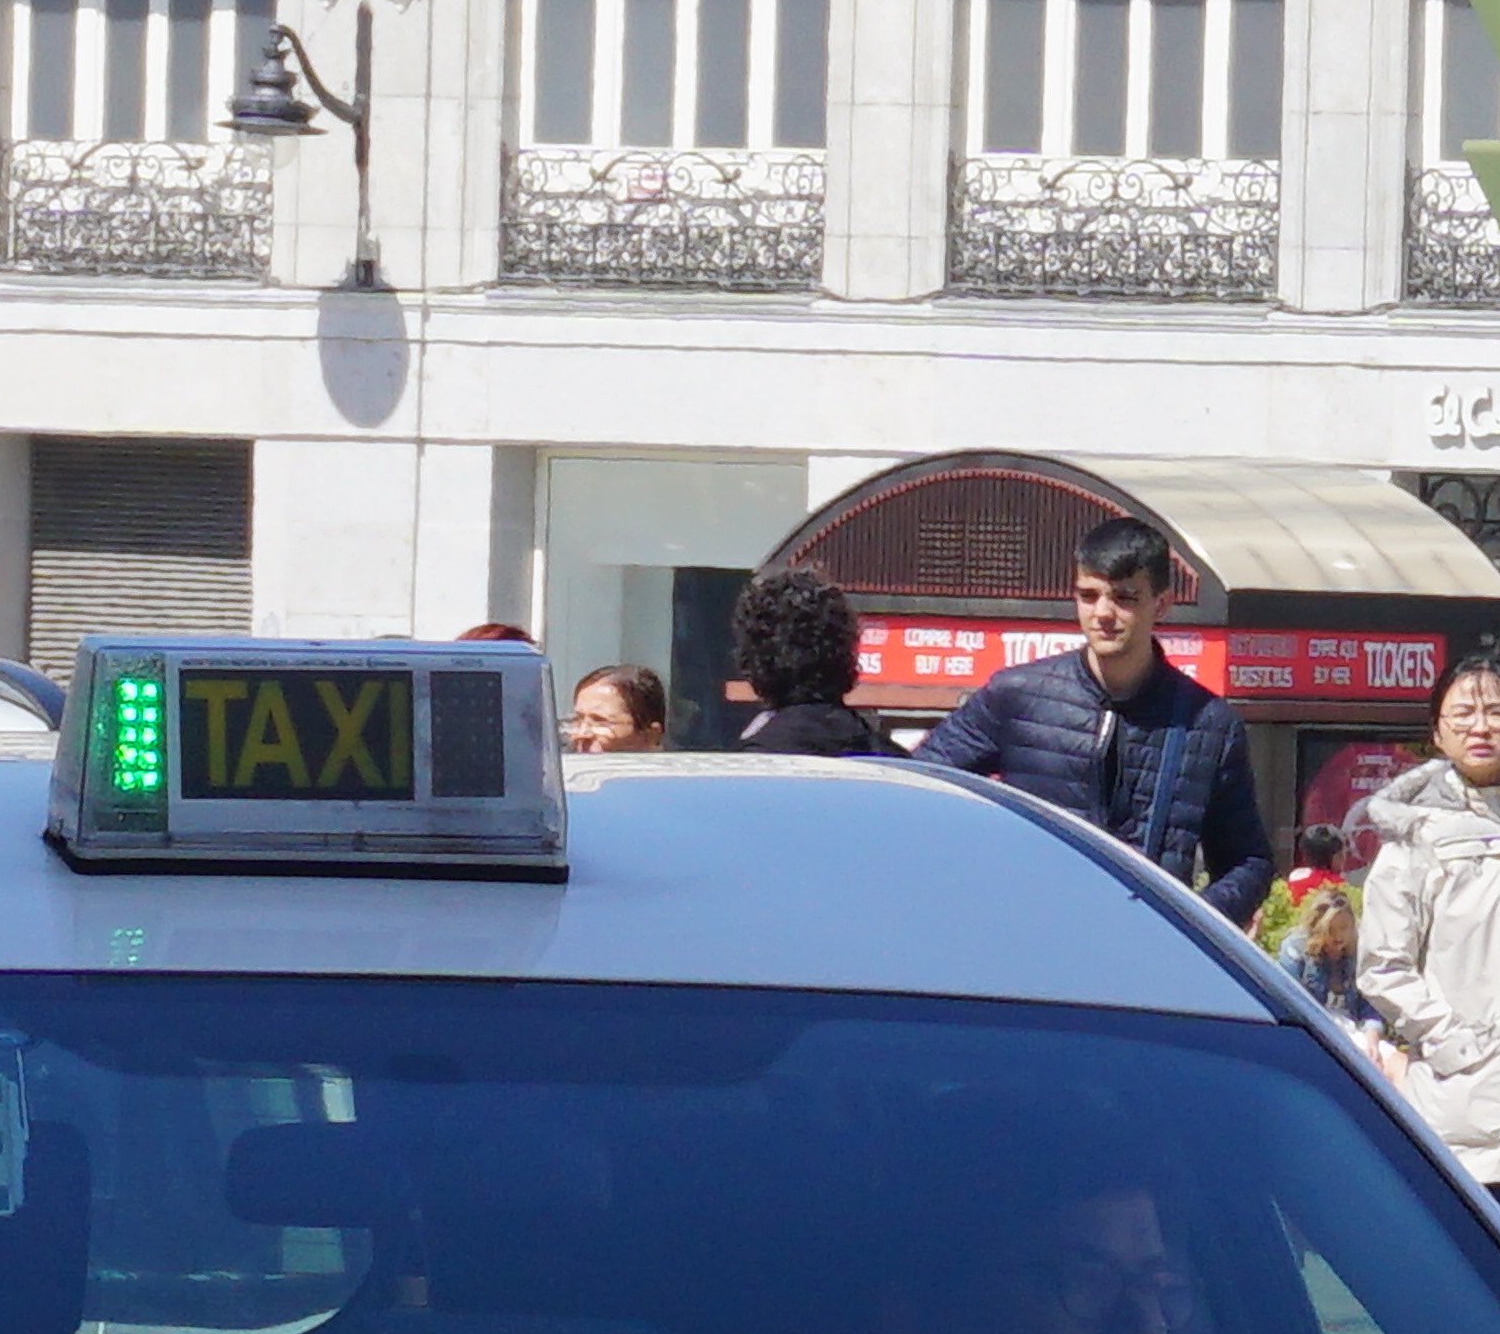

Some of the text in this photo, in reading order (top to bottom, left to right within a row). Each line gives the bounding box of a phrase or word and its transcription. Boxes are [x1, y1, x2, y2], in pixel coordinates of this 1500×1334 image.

[1426, 384, 1463, 446] El
[1363, 641, 1436, 688] TICKETS
[185, 680, 411, 788] TAXI
